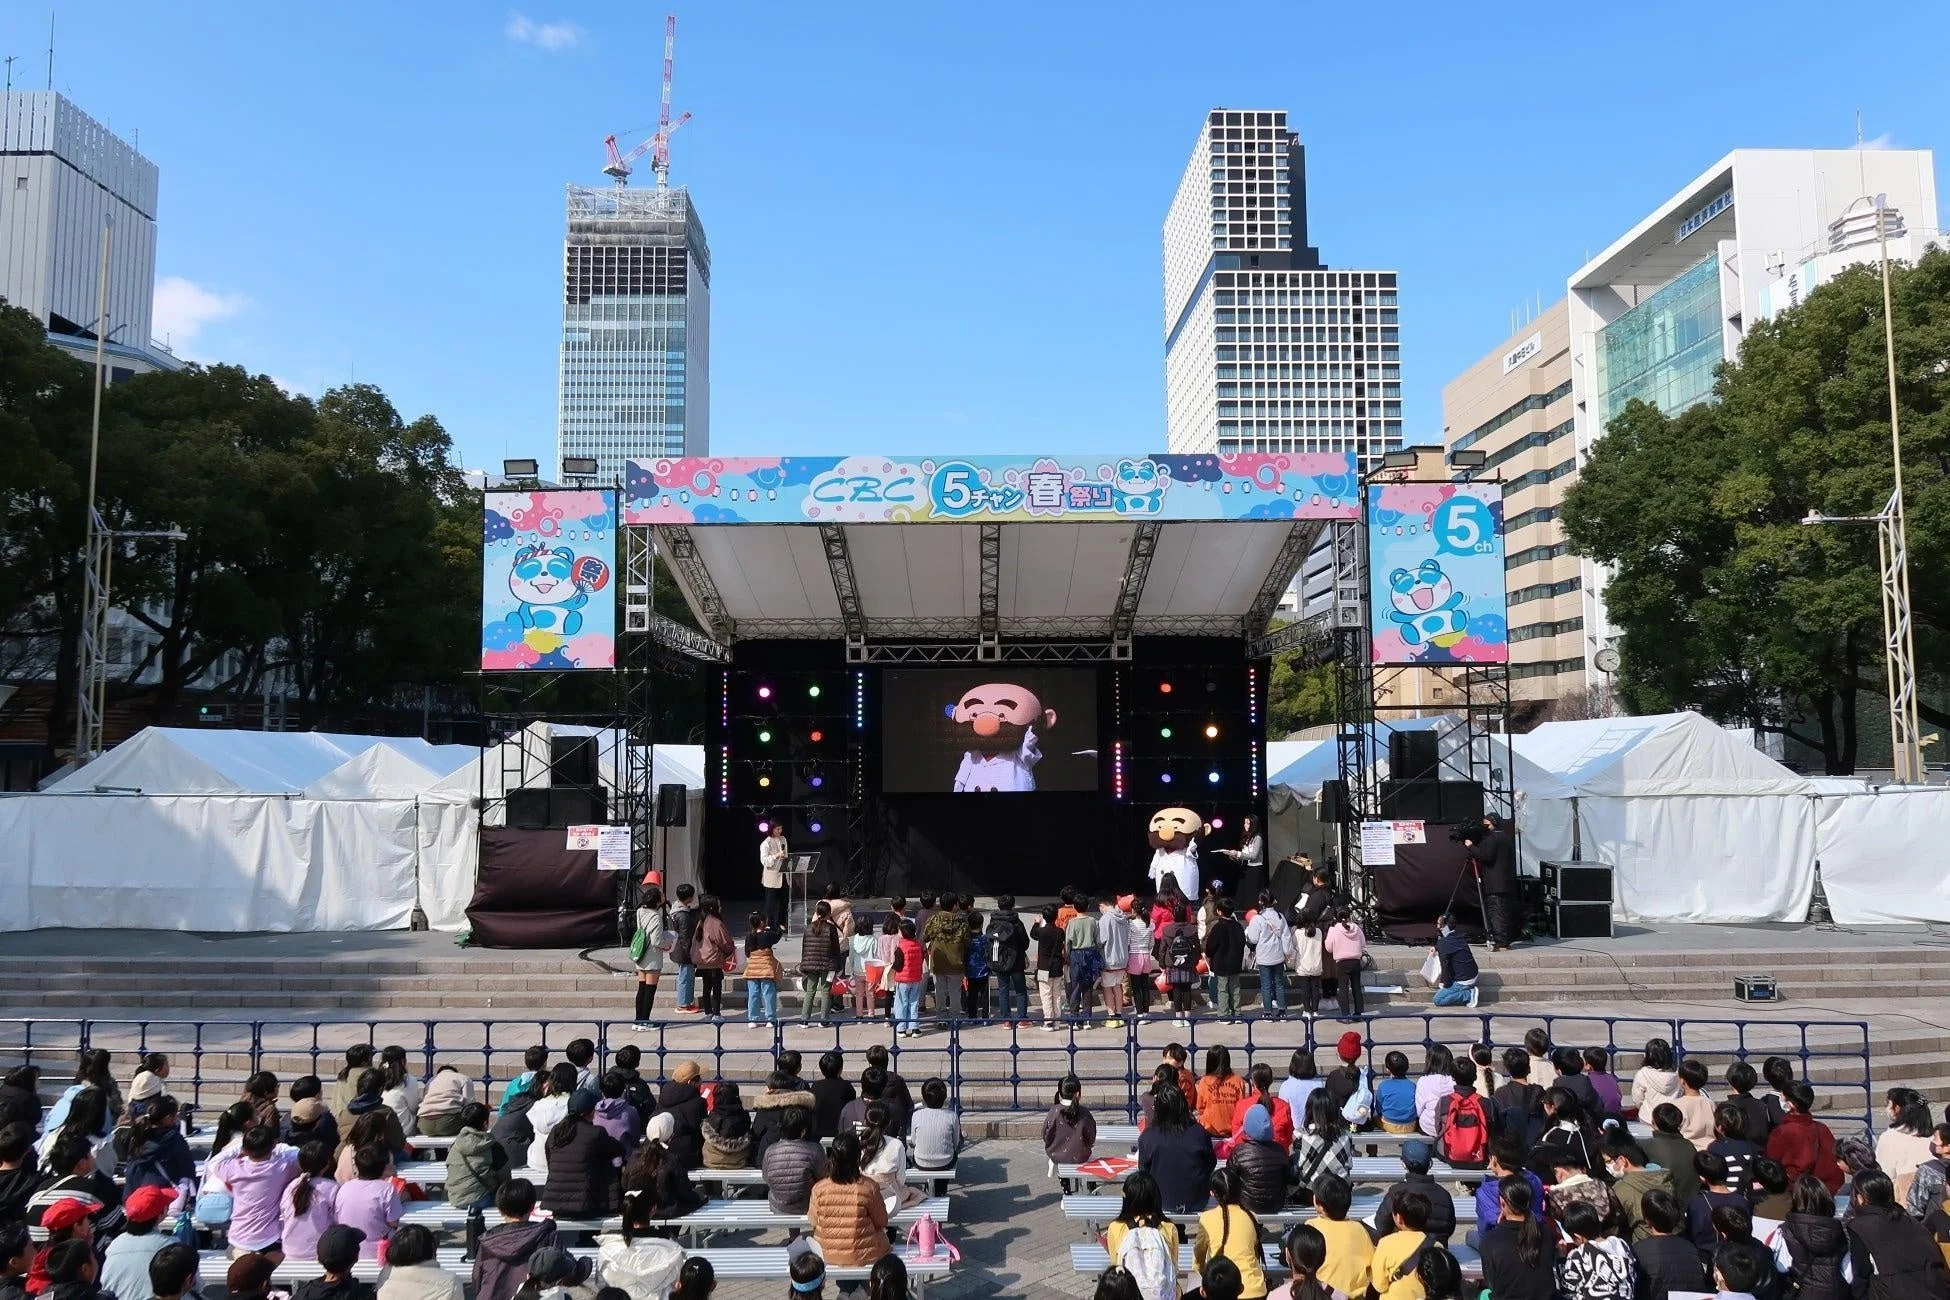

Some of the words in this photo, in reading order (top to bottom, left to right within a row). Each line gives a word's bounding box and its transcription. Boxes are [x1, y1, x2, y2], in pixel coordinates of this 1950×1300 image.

[812, 476, 918, 503] CBC
[942, 470, 1025, 510] 5チャン
[1027, 472, 1115, 509] 春祭り
